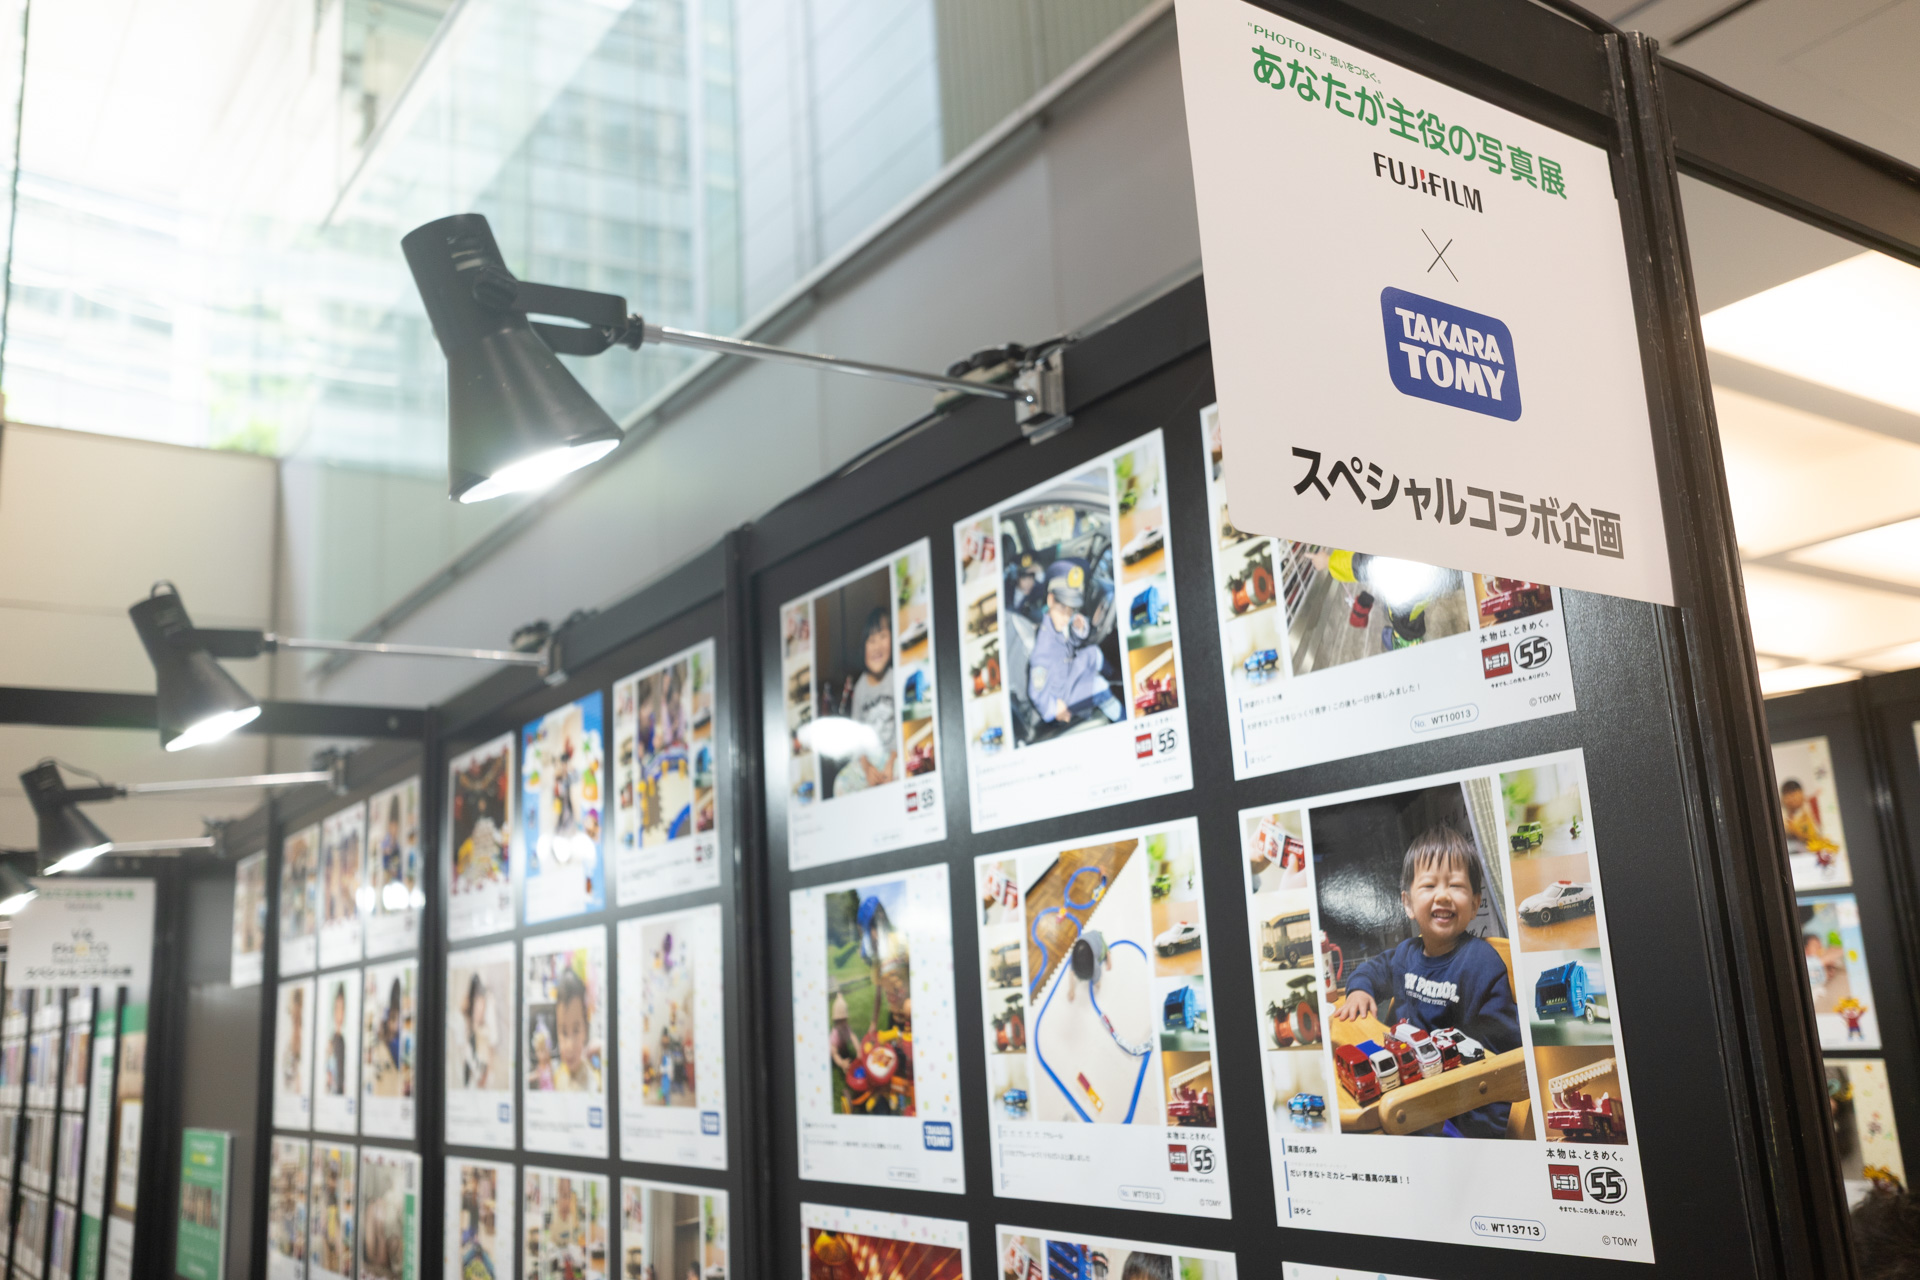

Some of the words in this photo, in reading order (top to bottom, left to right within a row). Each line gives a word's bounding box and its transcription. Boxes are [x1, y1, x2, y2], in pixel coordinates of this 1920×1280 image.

[1329, 54, 1382, 85] 想いをつなぐ。
[1251, 45, 1567, 200] あなたが主役の写真展
[1373, 152, 1483, 213] FUJIFILM
[1395, 307, 1504, 366] TAKARA
[1399, 342, 1506, 402] TOMY
[1291, 446, 1625, 560] スペシャルコラボ企画
[1479, 619, 1550, 644] 本物は、ときめく。
[1485, 652, 1510, 671] トミカ
[1518, 637, 1548, 669] 55
[1431, 709, 1472, 725] WT10013
[1193, 1148, 1215, 1171] 55
[1546, 1147, 1624, 1162] 本物は、ときめく。
[1552, 1173, 1580, 1191] トミカ
[1590, 1171, 1623, 1200] 55
[1558, 1205, 1626, 1217] 今までも、この先も、ありがとう。
[1474, 1221, 1488, 1231] No.
[1491, 1222, 1540, 1236] WT13713
